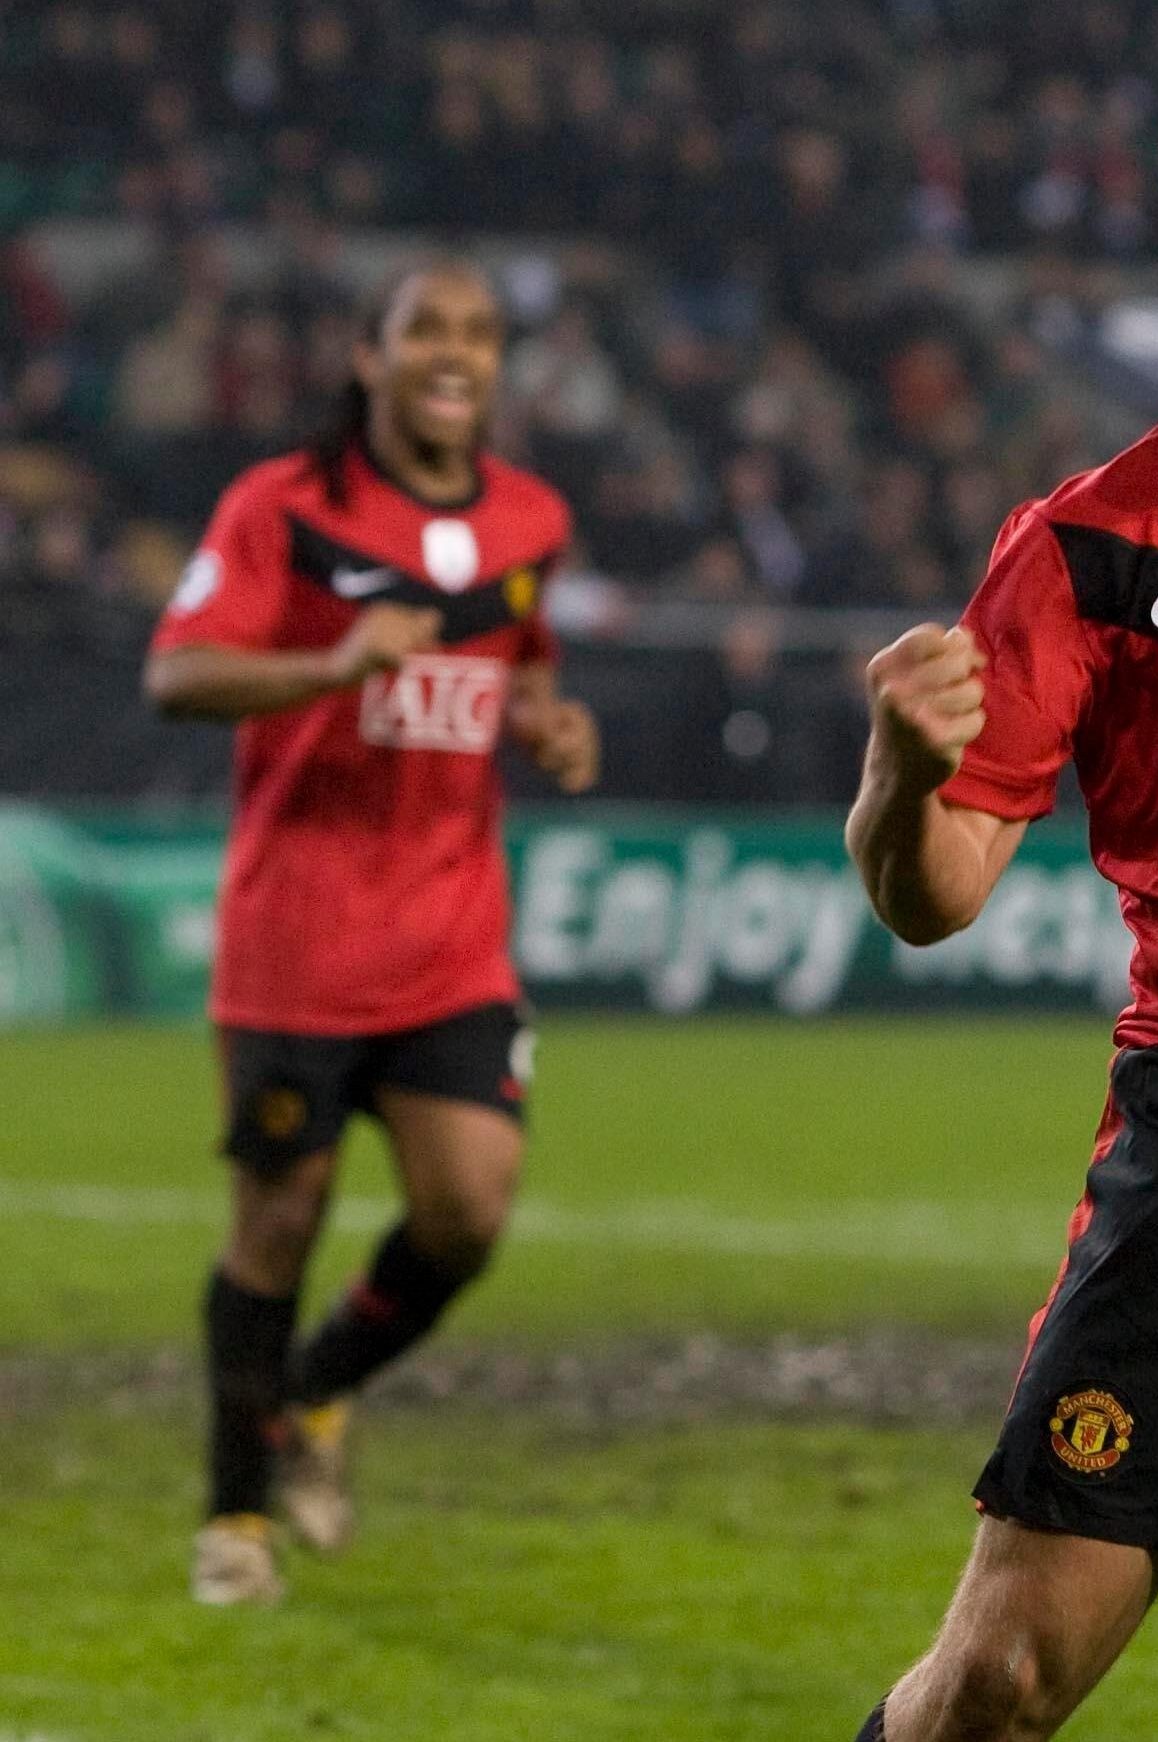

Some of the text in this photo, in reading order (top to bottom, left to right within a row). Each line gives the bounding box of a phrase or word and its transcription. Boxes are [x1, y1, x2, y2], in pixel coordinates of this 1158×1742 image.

[524, 828, 868, 1008] Enjoy
[1062, 1395, 1127, 1431] MANCHESTER
[1060, 1446, 1106, 1468] UNITED
